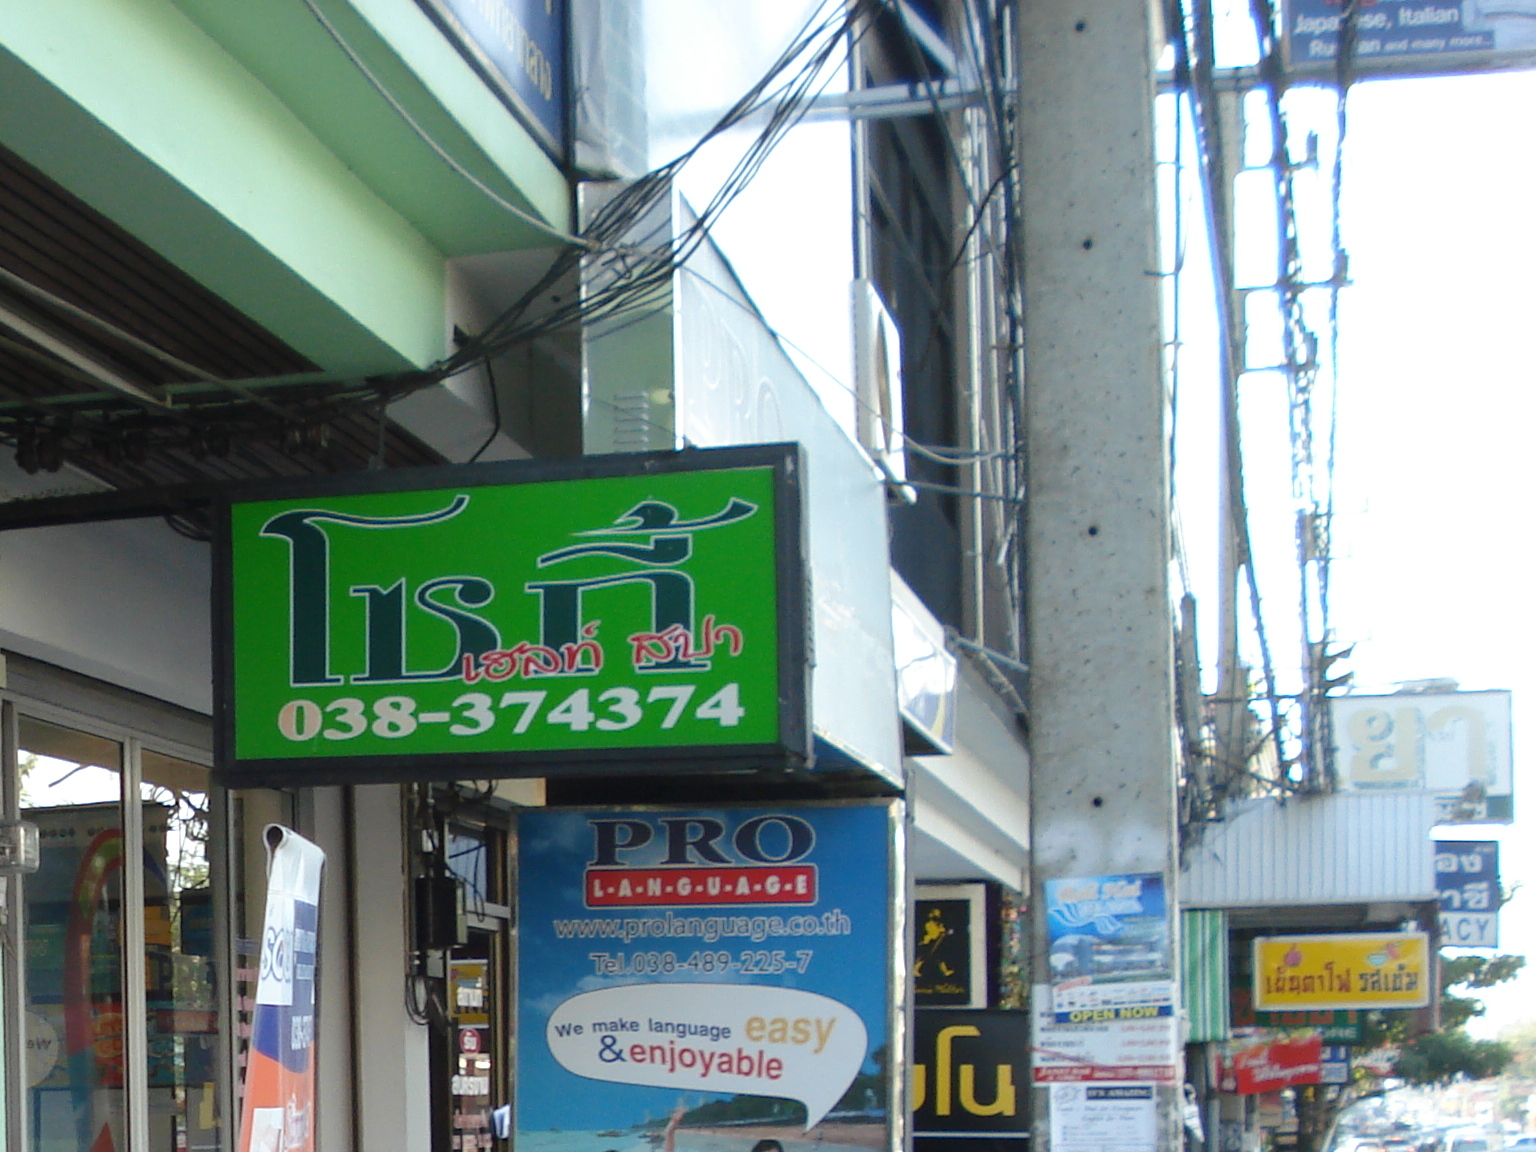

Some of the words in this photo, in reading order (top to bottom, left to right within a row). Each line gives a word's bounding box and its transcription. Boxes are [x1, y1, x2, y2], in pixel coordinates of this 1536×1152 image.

[1398, 6, 1460, 27] Italian
[463, 619, 604, 684] เฮลท์
[628, 614, 743, 667] สปา
[277, 683, 745, 742] 038-374374
[586, 814, 816, 868] PRO
[553, 909, 851, 943] www.prolanguage.co.th
[554, 1022, 584, 1038] We
[592, 1018, 640, 1034] make
[648, 1017, 732, 1040] language
[744, 1015, 839, 1055] easy
[1069, 1010, 1115, 1023] OPEN
[1120, 1007, 1159, 1018] NOW
